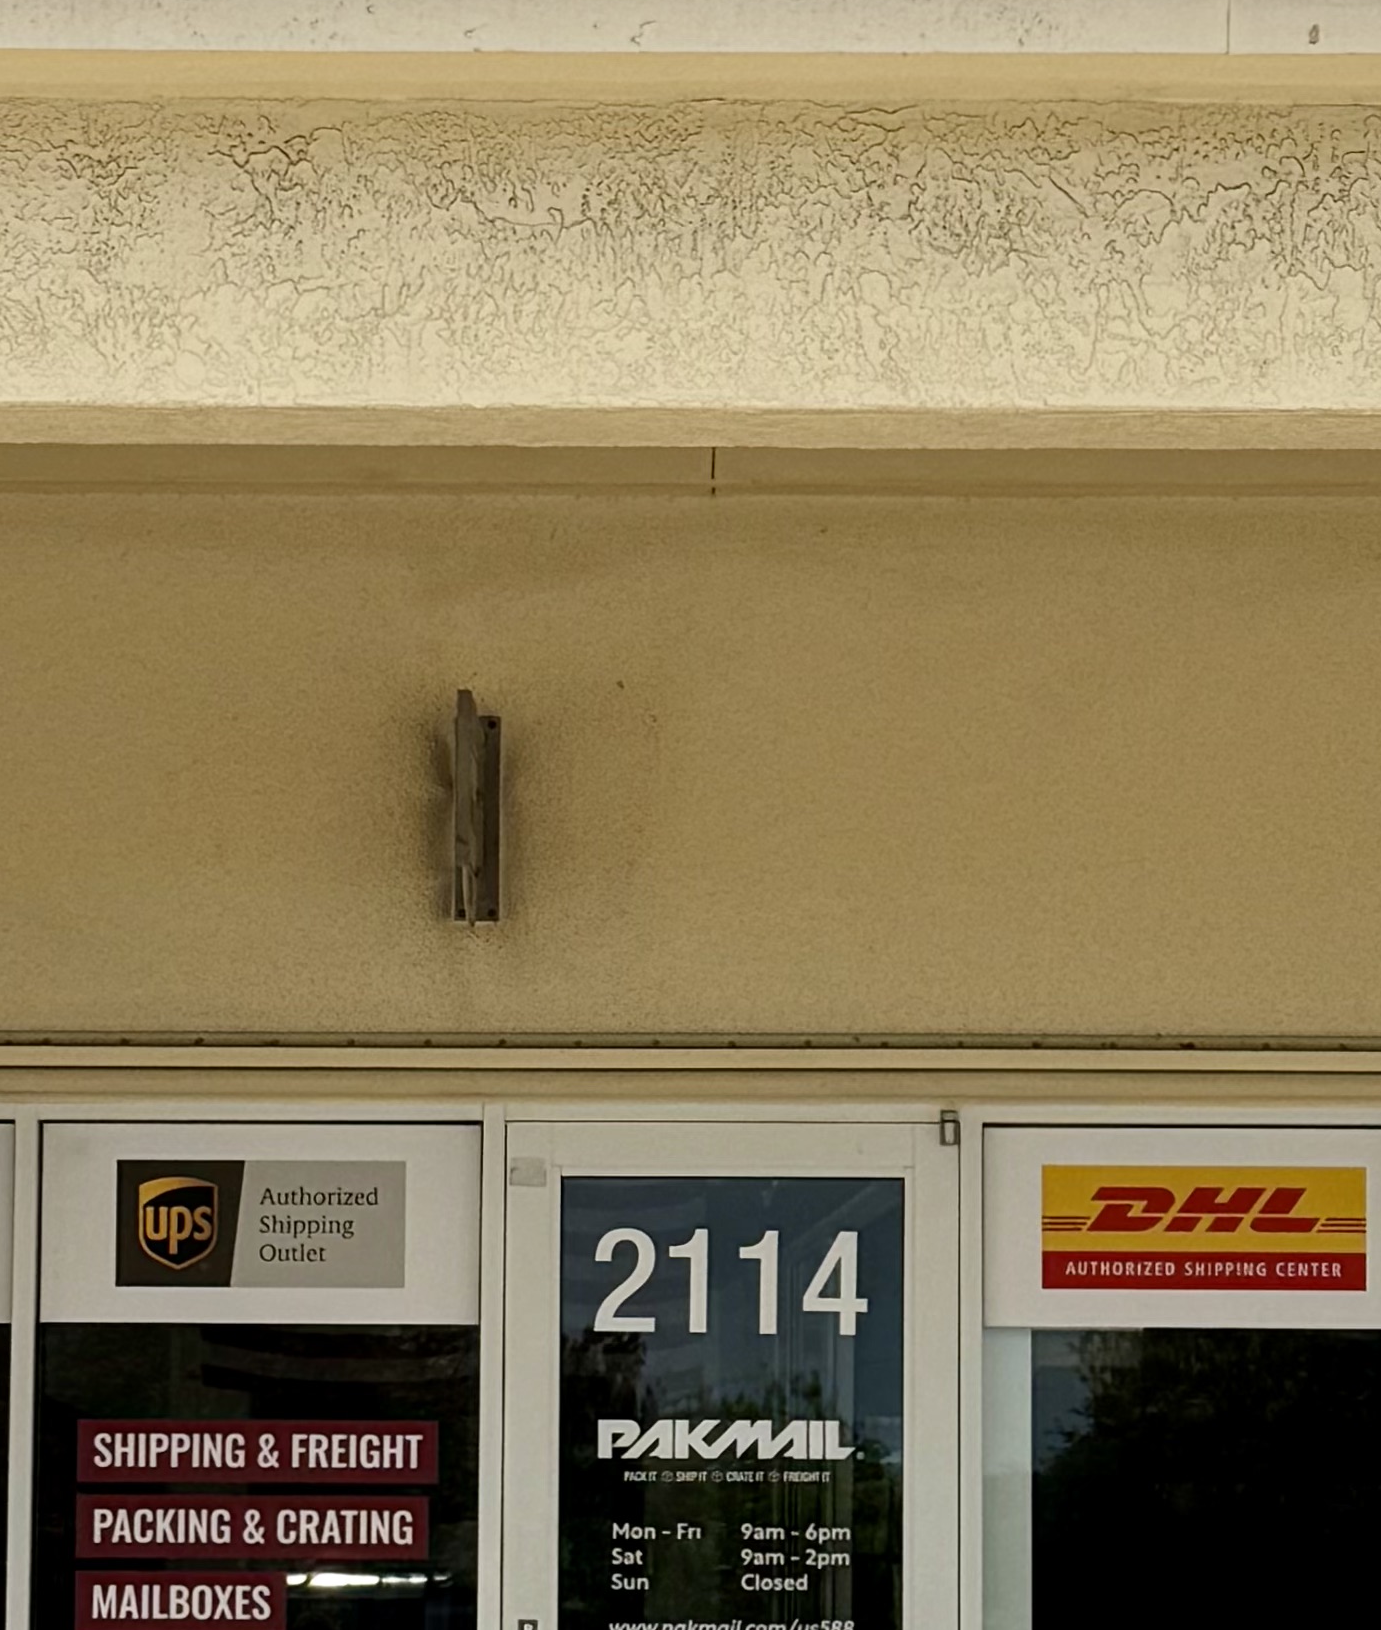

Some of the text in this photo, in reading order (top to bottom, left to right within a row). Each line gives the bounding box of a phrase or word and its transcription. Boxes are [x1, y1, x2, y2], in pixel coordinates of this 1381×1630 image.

[258, 1185, 379, 1207] Authorized
[1085, 1186, 1321, 1234] DHL
[143, 1203, 215, 1247] ups
[258, 1213, 355, 1240] Shipping
[258, 1243, 326, 1264] Outlet
[1065, 1260, 1344, 1279] AUTHORIZED SHIPPING CENTER
[593, 1228, 869, 1336] 2114
[93, 1433, 424, 1469] SHIPPING & FREIGHT
[92, 1508, 414, 1546] PACKING & CRATING
[612, 1523, 657, 1540] Mon
[740, 1523, 785, 1540] 9am
[805, 1523, 851, 1545] 6pm
[611, 1548, 643, 1565] Sat
[740, 1549, 785, 1566] 9am
[805, 1549, 850, 1570] 2pm
[611, 1574, 650, 1590] Sun
[741, 1574, 808, 1591] Closed
[90, 1584, 272, 1620] MAILBOXES
